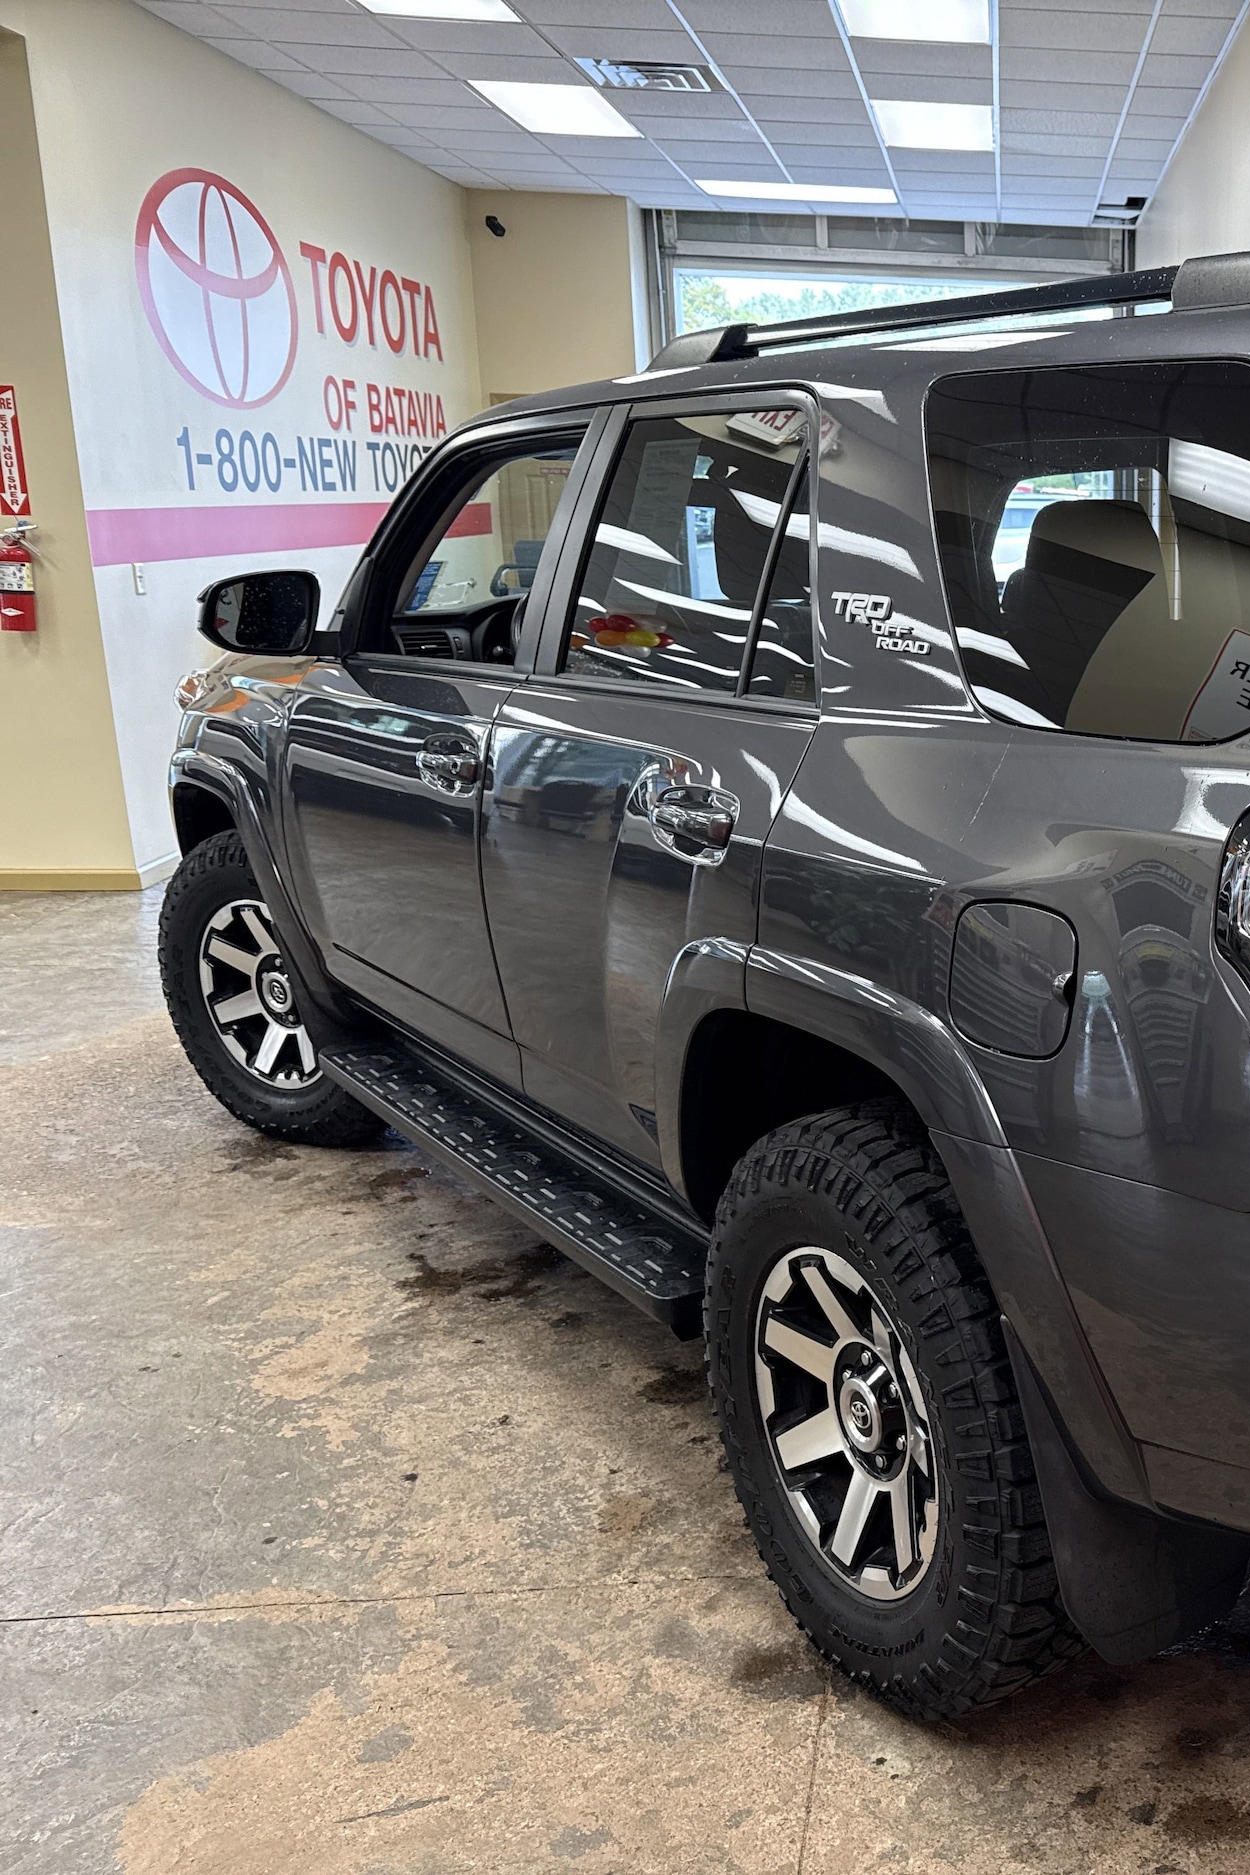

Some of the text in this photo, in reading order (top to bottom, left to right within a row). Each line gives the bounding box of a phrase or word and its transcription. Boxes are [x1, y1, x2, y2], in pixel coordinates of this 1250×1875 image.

[300, 240, 443, 361] TOYOTA
[323, 375, 447, 439] OF BATAVIA
[0, 414, 19, 506] EXTINGUISHER
[176, 427, 432, 493] 1-800-NEW TOYO
[831, 592, 892, 625] TRD
[871, 620, 914, 638] OFF
[876, 636, 931, 655] ROAD
